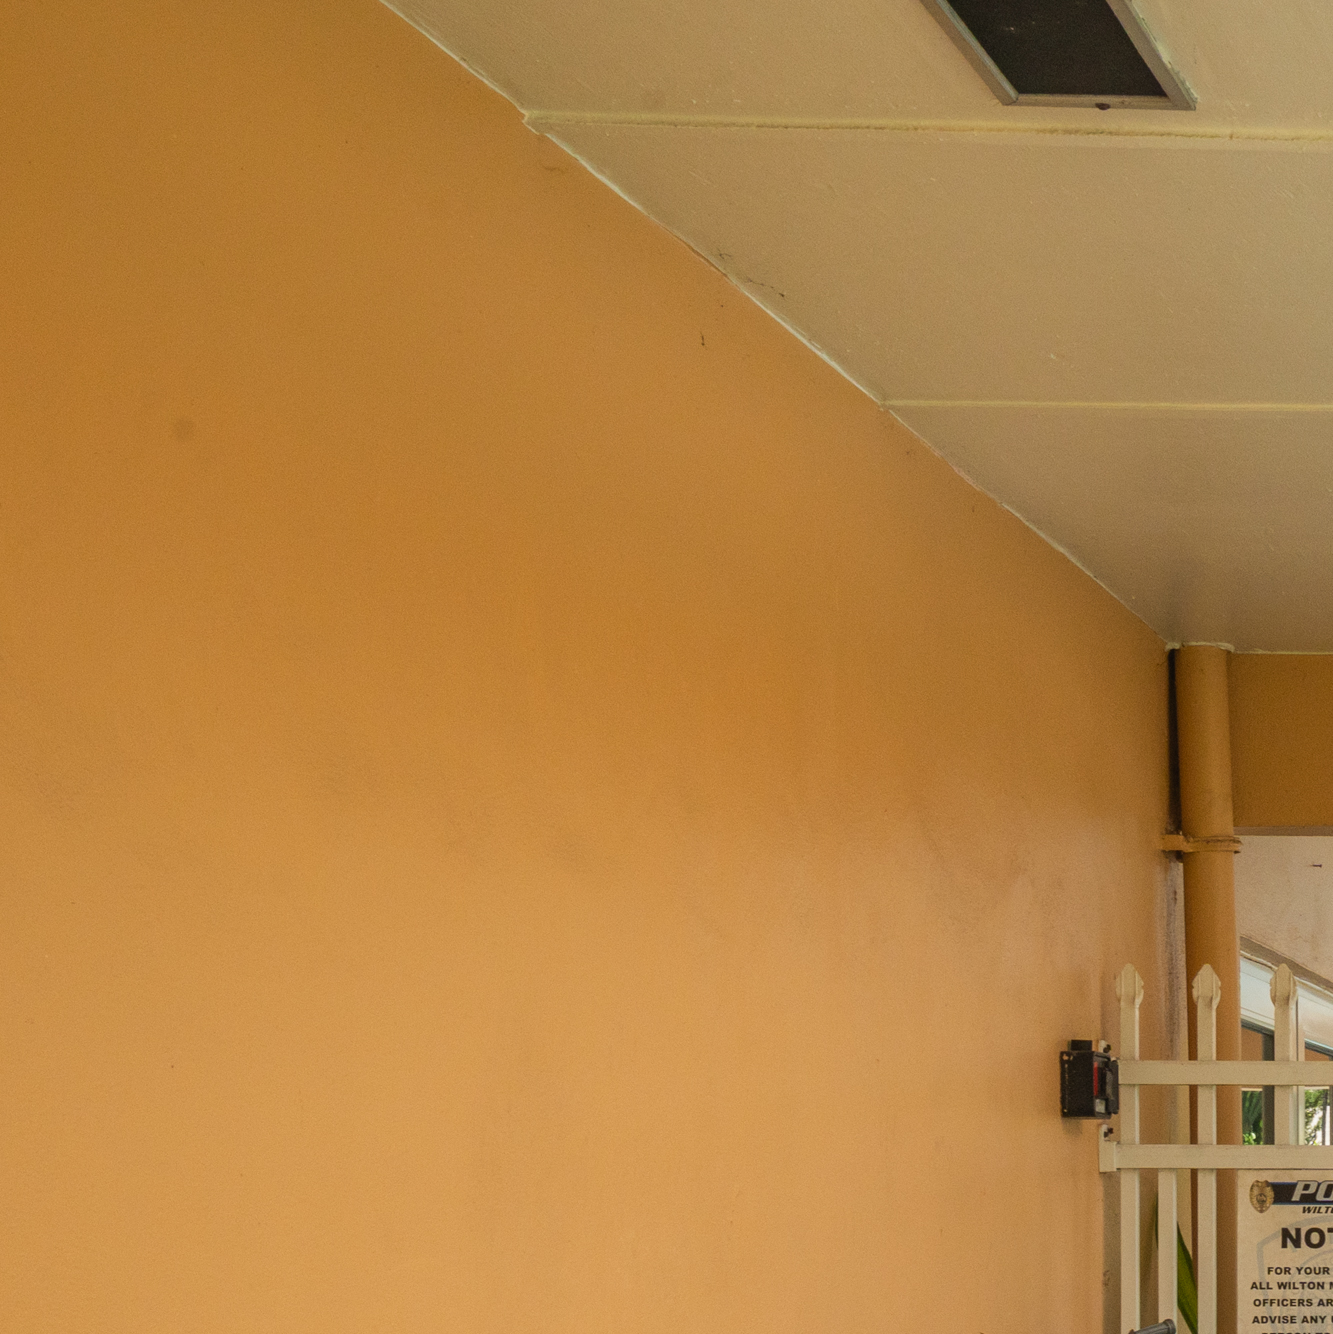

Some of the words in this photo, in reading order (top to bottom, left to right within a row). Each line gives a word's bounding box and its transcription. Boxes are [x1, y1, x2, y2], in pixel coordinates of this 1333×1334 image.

[1267, 1266, 1292, 1276] FOR
[1295, 1266, 1330, 1276] YOUR
[1250, 1281, 1273, 1291] ALL
[1276, 1281, 1325, 1291] WILTON
[1253, 1298, 1314, 1308] OFFICERS
[1251, 1315, 1297, 1325] ADVISE
[1300, 1315, 1327, 1325] ANY
